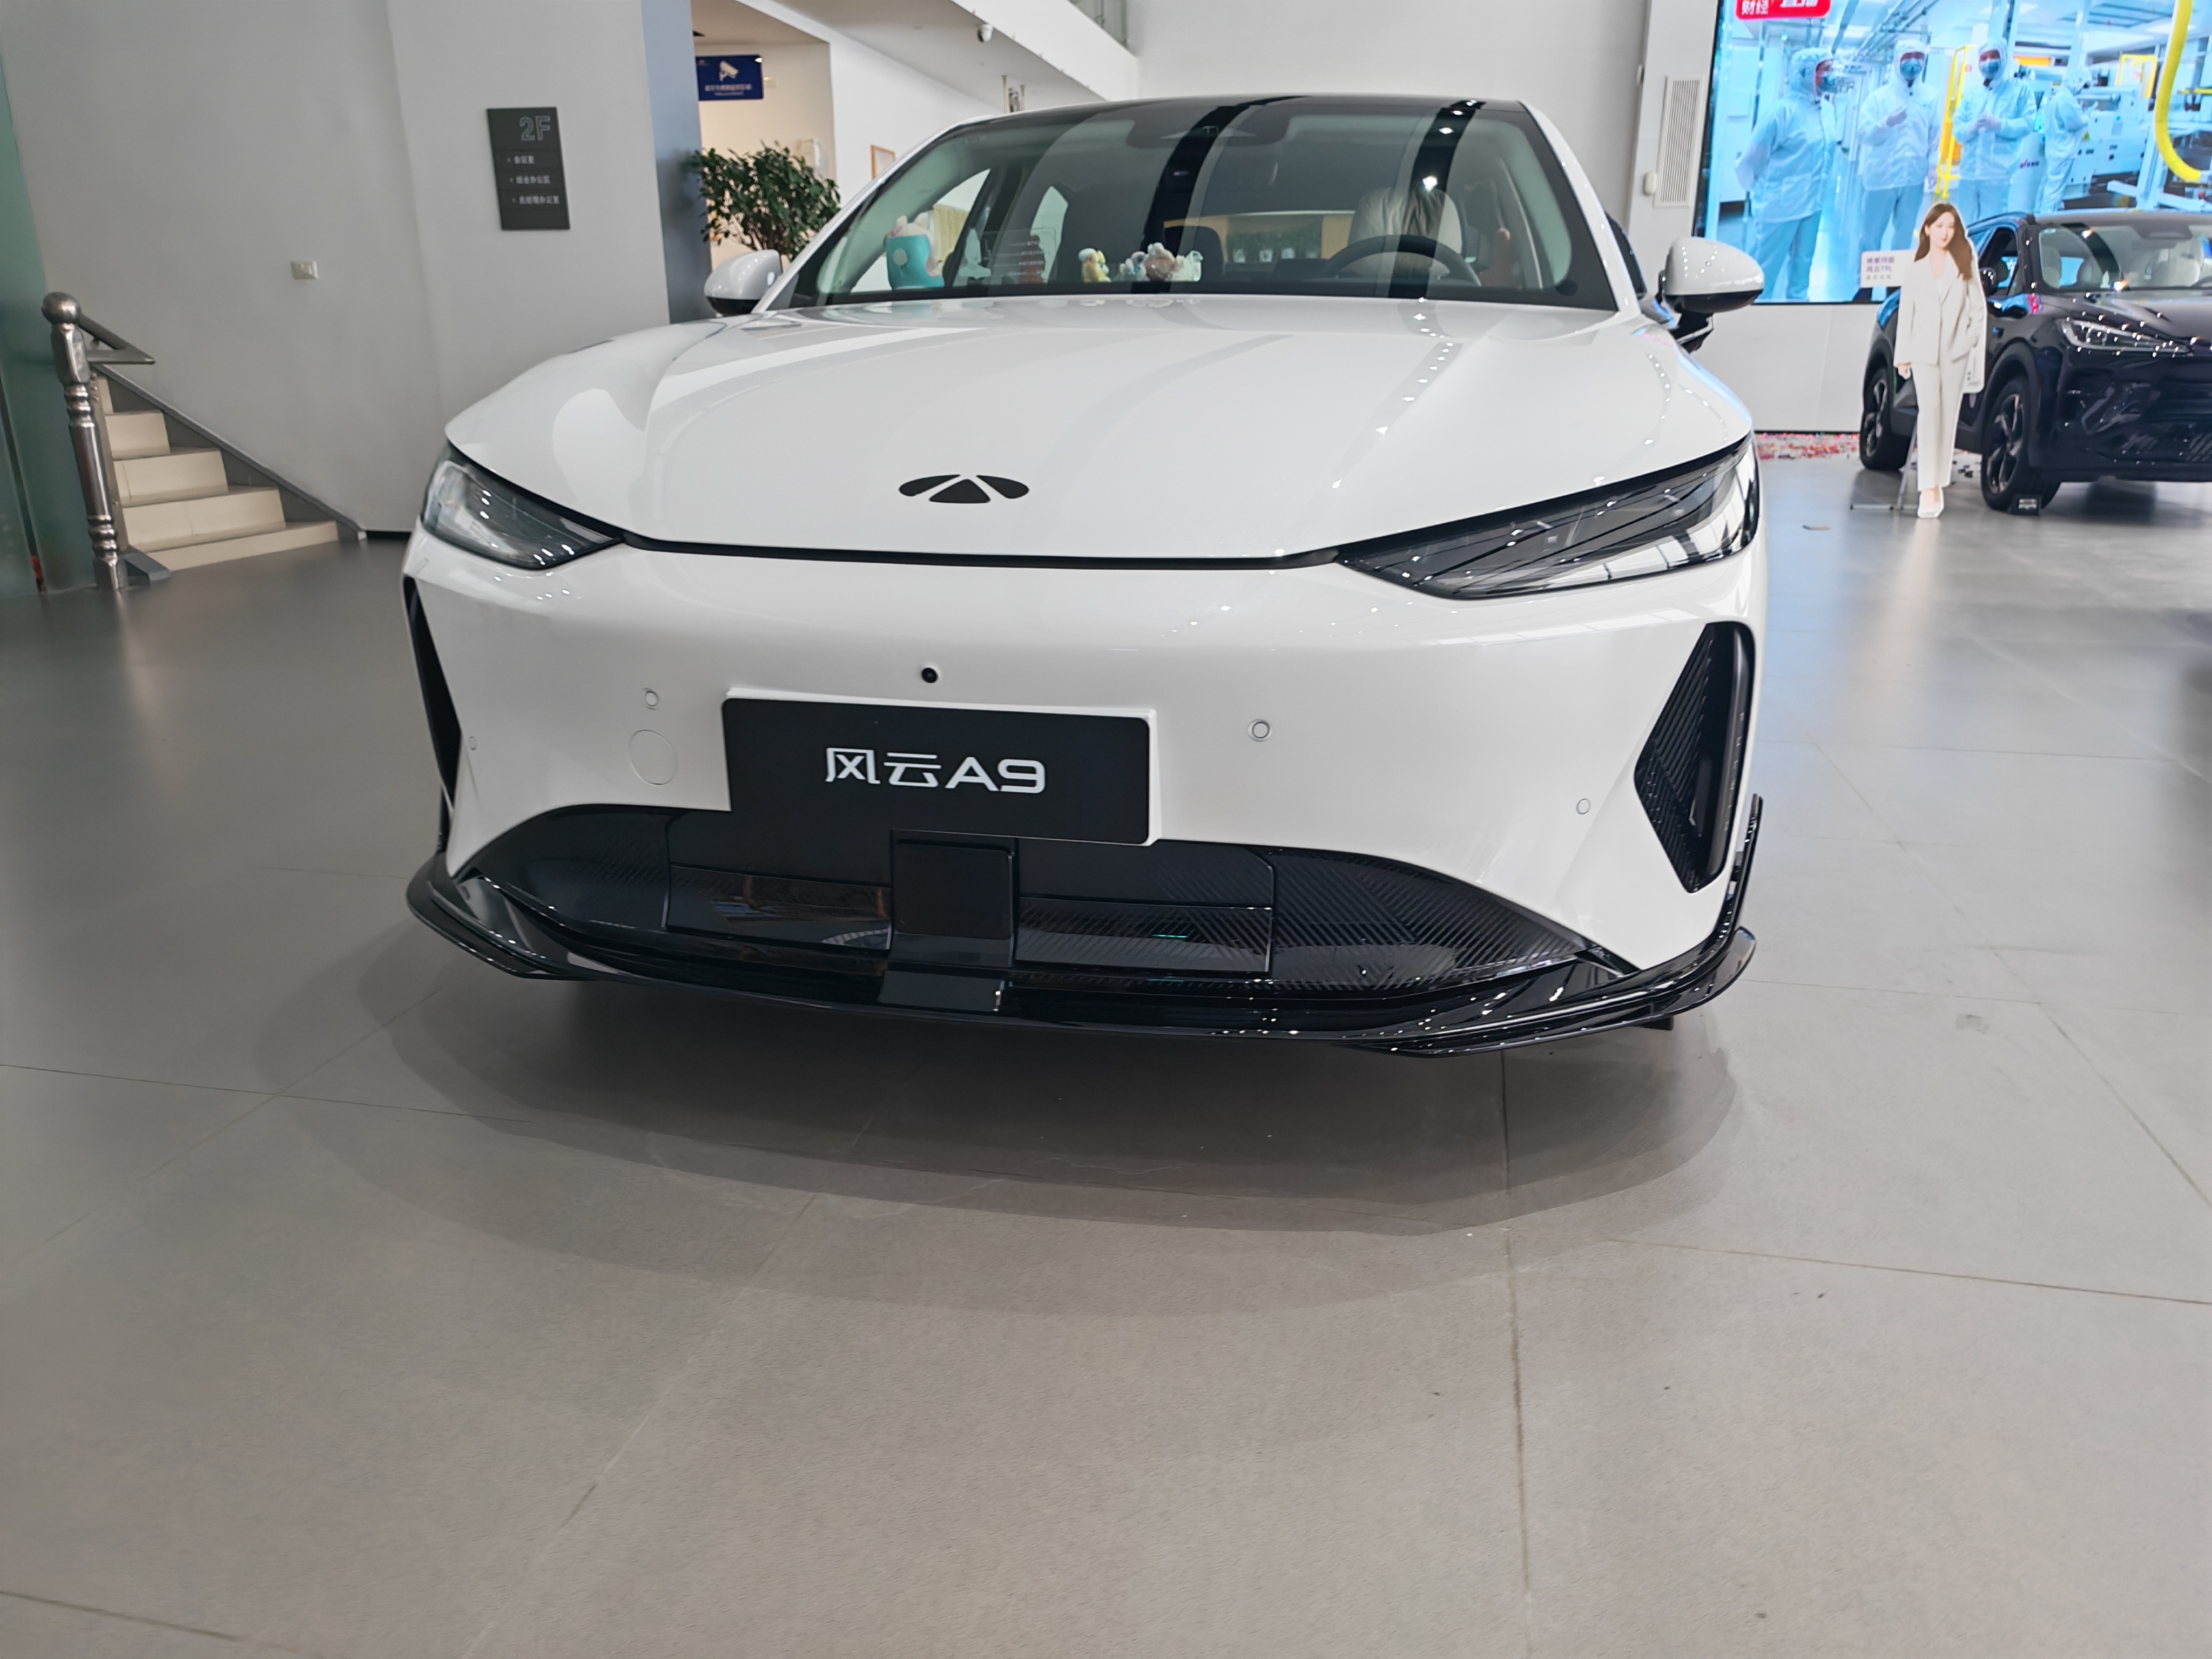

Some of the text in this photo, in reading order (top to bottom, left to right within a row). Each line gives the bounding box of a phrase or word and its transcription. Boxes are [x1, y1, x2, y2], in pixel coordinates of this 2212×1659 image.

[1742, 0, 1769, 15] 财经
[519, 115, 551, 141] 2F
[825, 747, 1046, 794] 风云A9
